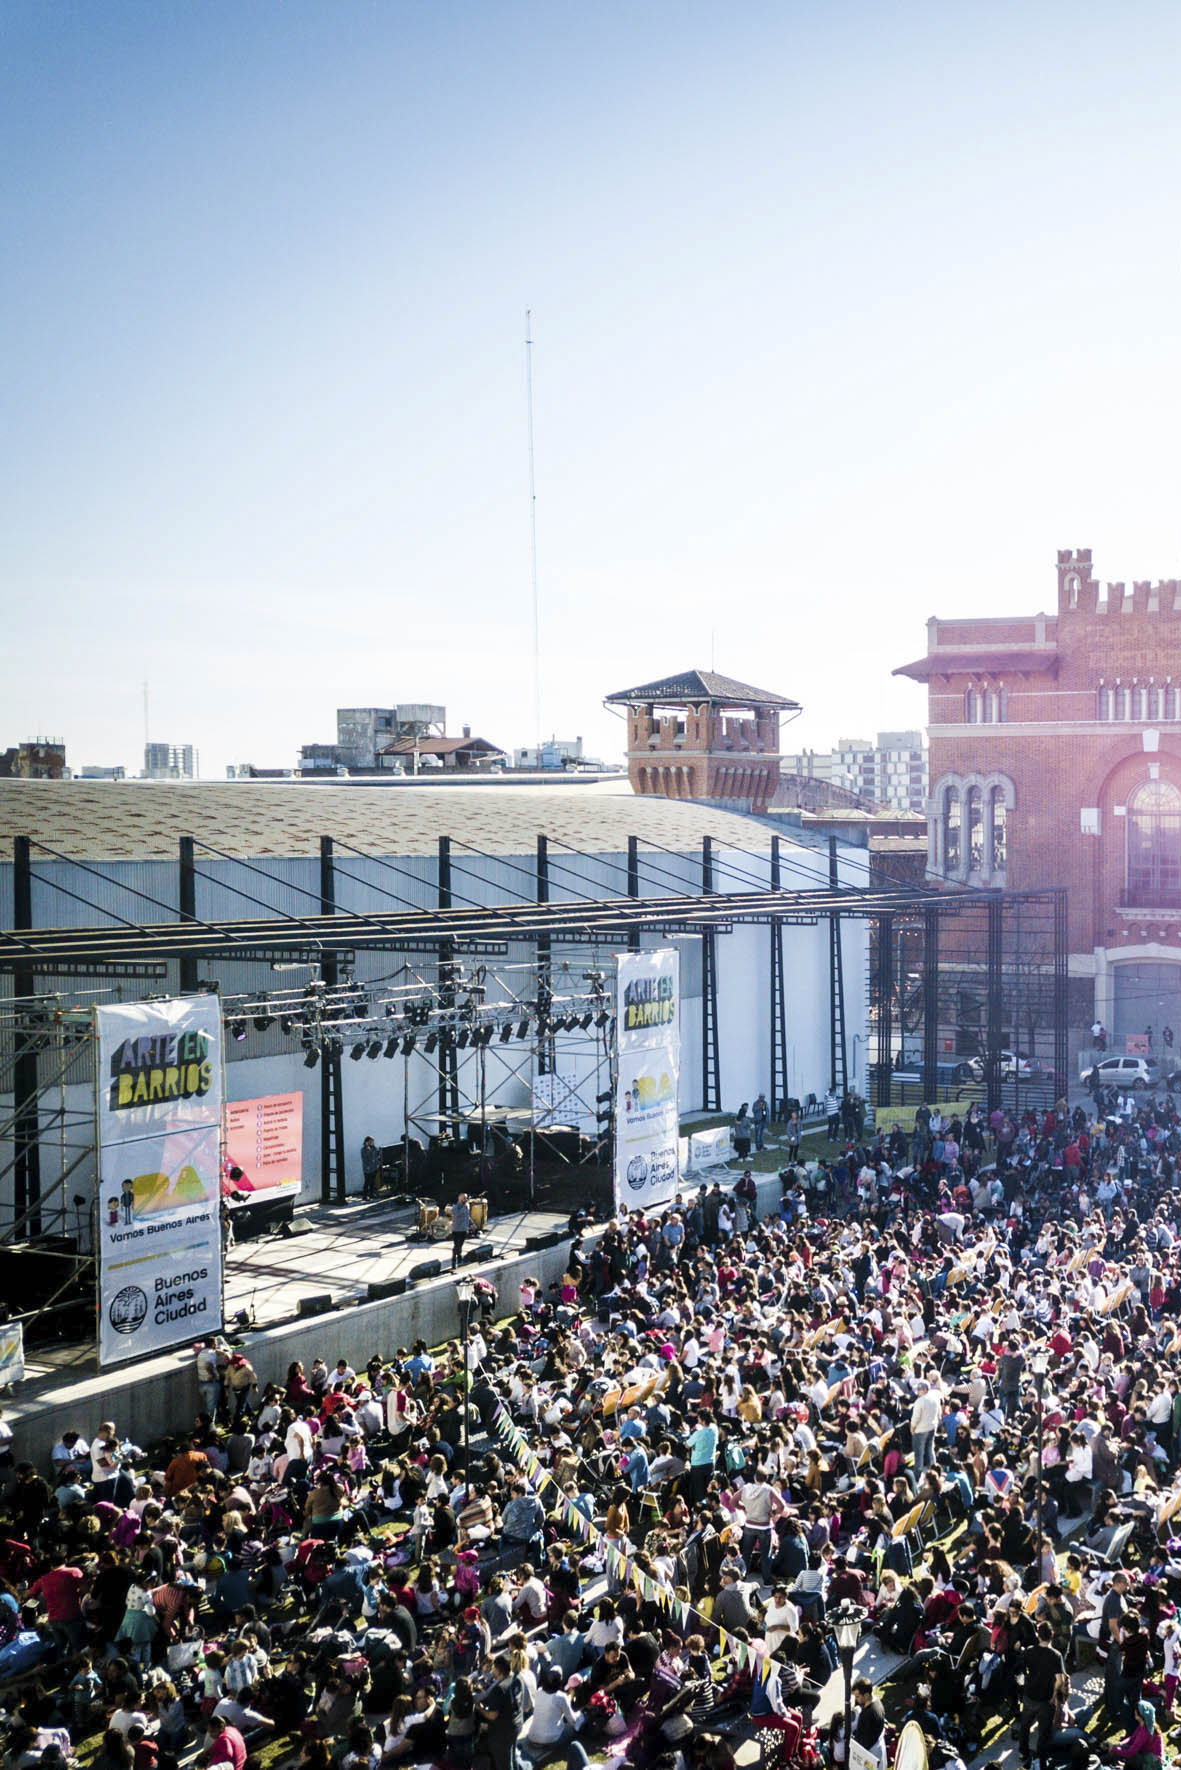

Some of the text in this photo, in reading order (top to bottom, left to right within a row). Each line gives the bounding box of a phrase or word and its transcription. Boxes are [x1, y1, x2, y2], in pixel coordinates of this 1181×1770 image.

[622, 975, 674, 1002] ARTE EN
[627, 1000, 676, 1027] BARRIOS
[117, 1028, 209, 1068] ARTE EN
[118, 1061, 213, 1105] BARRIOS
[650, 1168, 675, 1186] Ciudad
[110, 1212, 210, 1243] Vamos Buenos Aires
[154, 1268, 208, 1292] Buenos
[154, 1288, 194, 1310] Aires
[154, 1297, 207, 1325] Ciudad
